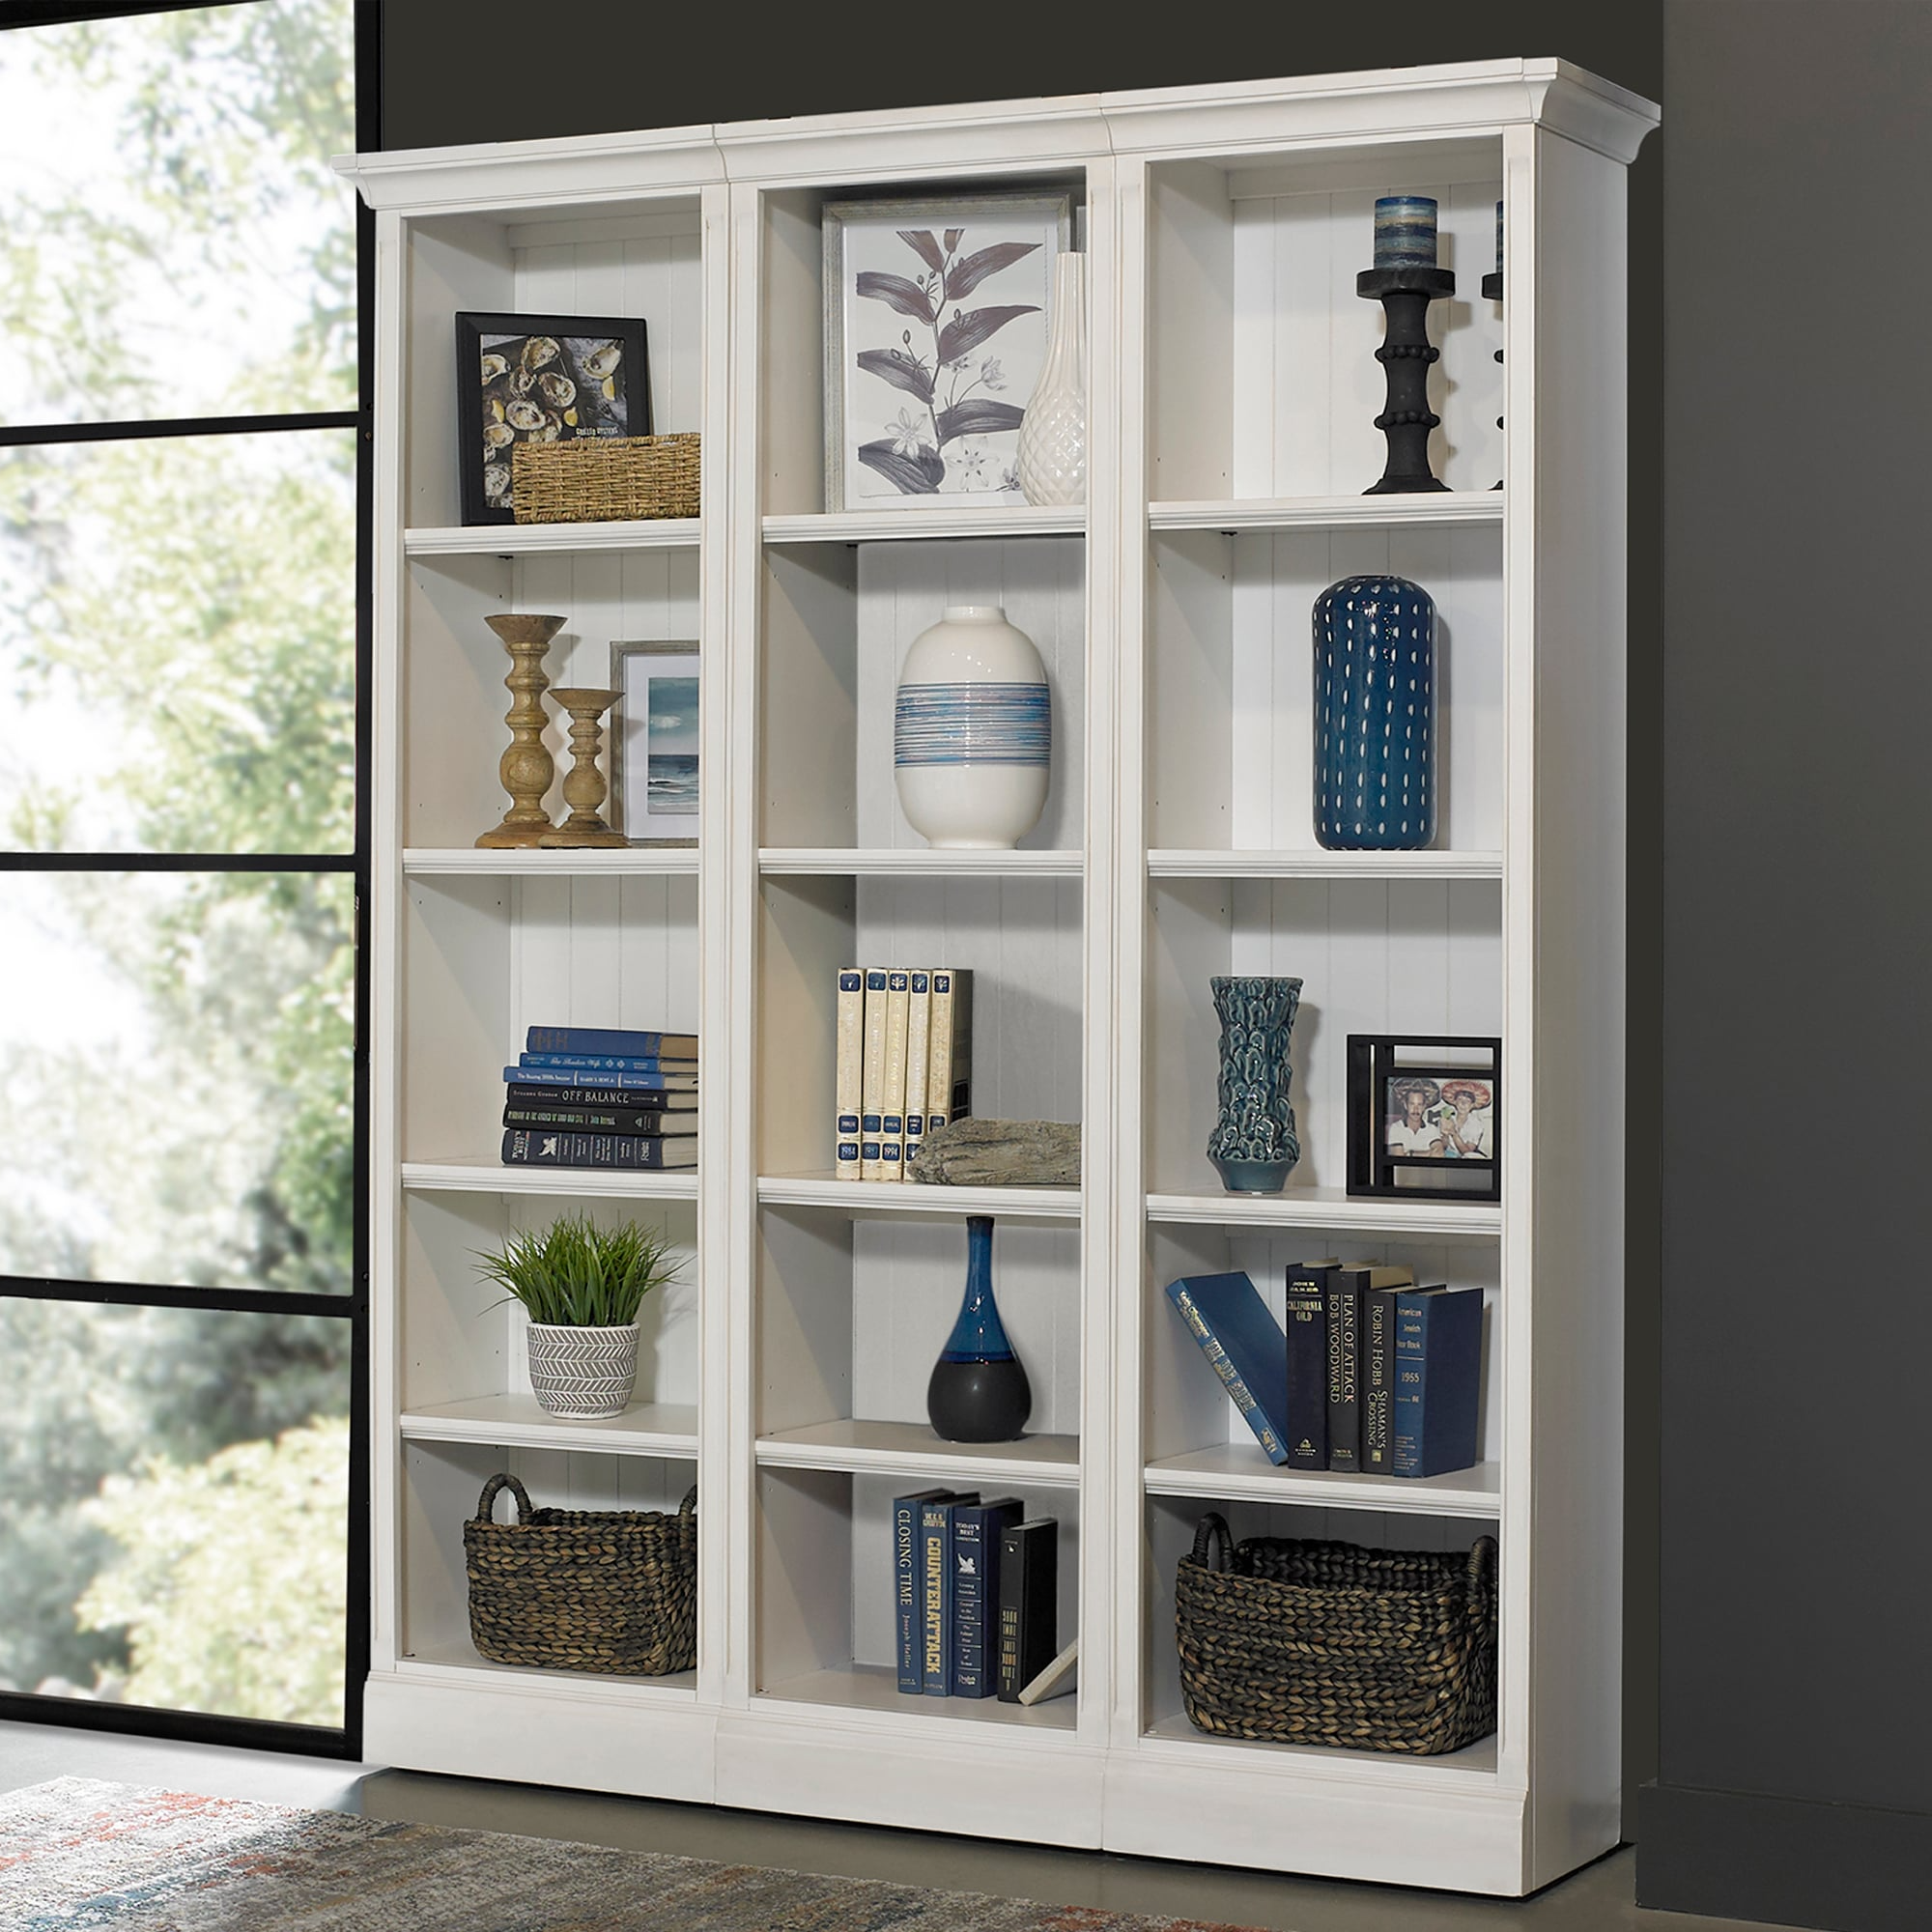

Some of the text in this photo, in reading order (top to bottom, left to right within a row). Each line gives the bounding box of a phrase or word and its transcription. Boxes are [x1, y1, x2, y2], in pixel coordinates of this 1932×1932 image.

[562, 1090, 630, 1104] OFF BALANCE
[1287, 1300, 1322, 1312] CALIFORNIA
[1295, 1311, 1313, 1321] GOLD
[1329, 1294, 1340, 1404] BOB WOODWARD
[1344, 1294, 1355, 1404] PLAN OF ATTACK
[1372, 1305, 1383, 1386] ROBIN HOBB
[1402, 1372, 1420, 1382] 1955
[1367, 1392, 1378, 1446] CROSSING
[1377, 1390, 1388, 1449] SHAMAN'S
[897, 1509, 913, 1605] CLOSING TIME
[902, 1614, 911, 1640] Joseph
[926, 1537, 942, 1674] COUNTERATTACK
